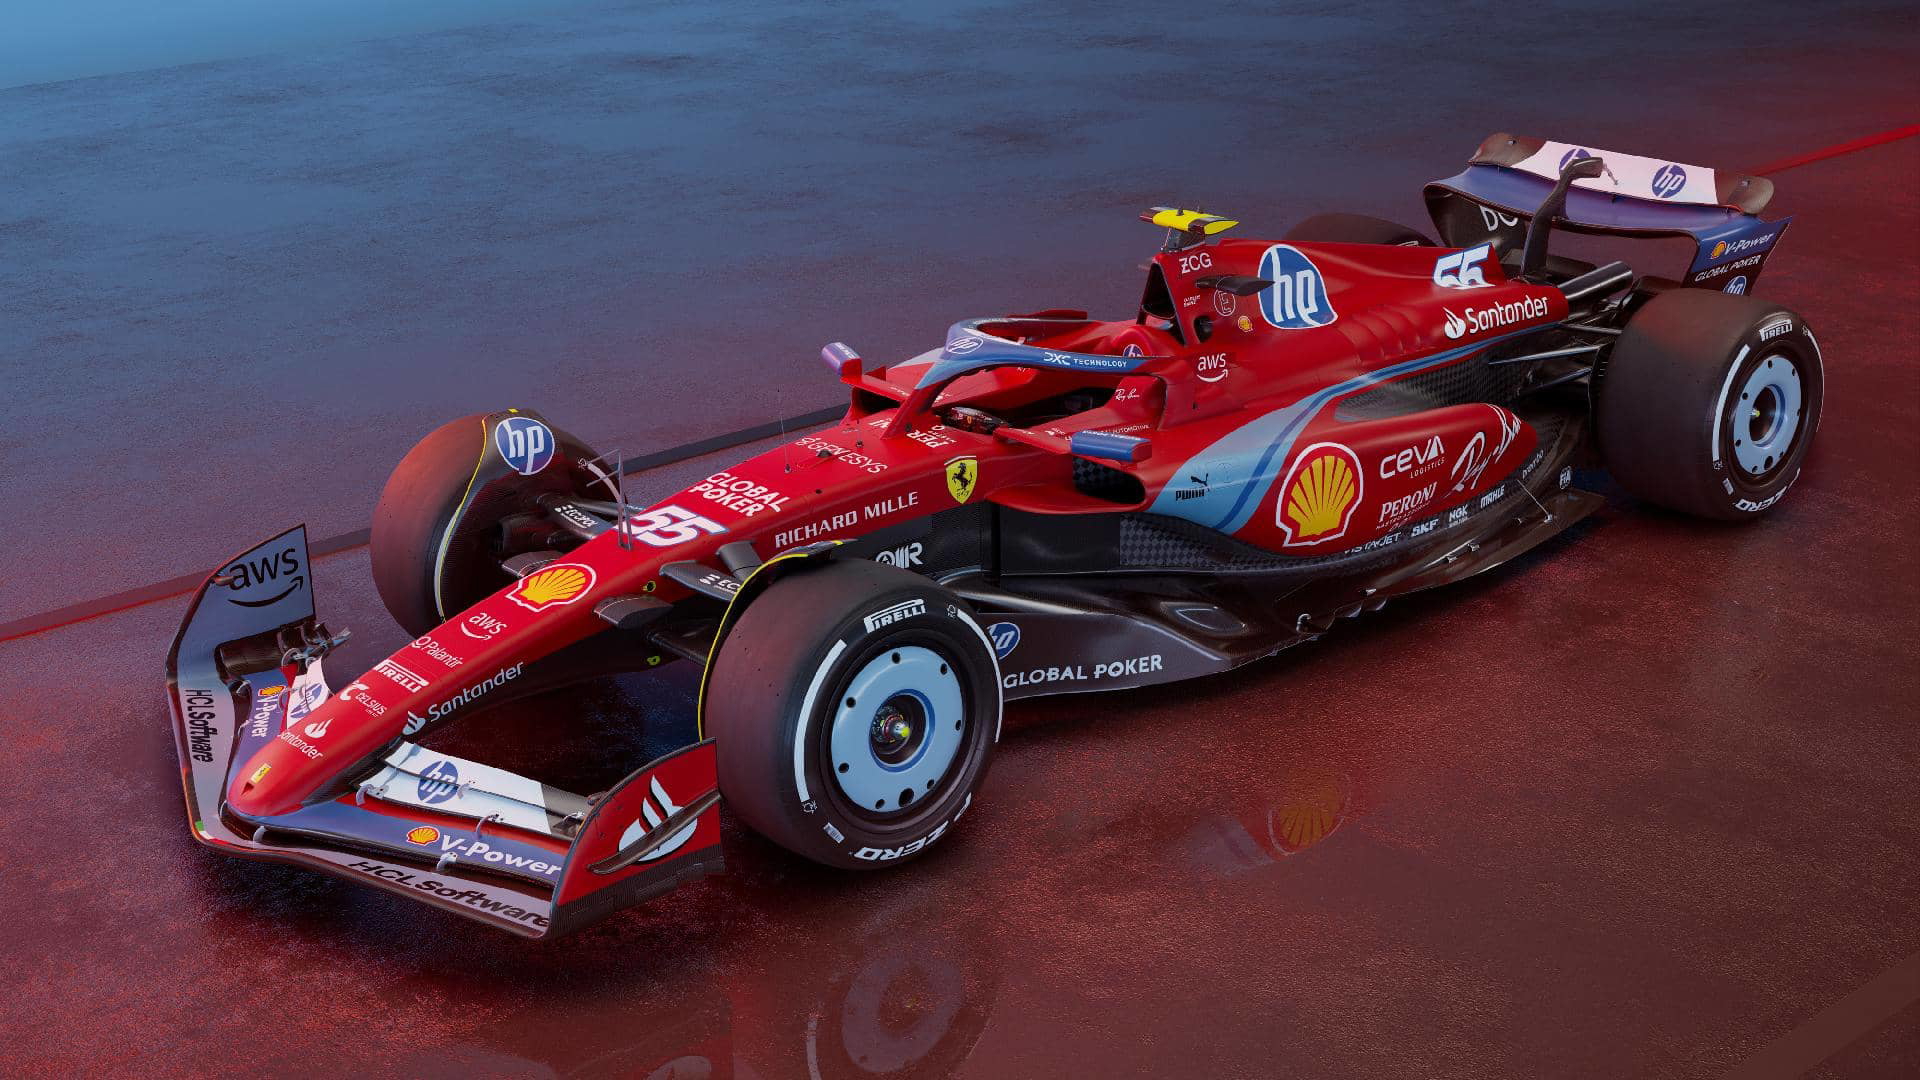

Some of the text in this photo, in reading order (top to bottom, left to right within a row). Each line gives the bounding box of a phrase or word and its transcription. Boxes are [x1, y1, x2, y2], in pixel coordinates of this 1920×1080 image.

[1655, 154, 1685, 198] hp
[1724, 233, 1774, 255] V-Power
[1179, 252, 1212, 274] ZCG
[1433, 243, 1496, 290] 55
[1269, 246, 1319, 327] hp
[1465, 295, 1548, 334] Santander
[1759, 319, 1793, 341] PIRELLI
[1043, 352, 1128, 368] DXC TECHNOLOGY
[1198, 353, 1227, 371] aws
[502, 418, 545, 475] hp
[808, 441, 888, 473] GENESYS
[1410, 457, 1445, 479] LOGISTICS
[689, 483, 765, 517] POKER
[706, 472, 790, 513] GLOBAL
[1378, 481, 1438, 523] PERONI
[1411, 519, 1439, 537] SKF
[1449, 504, 1468, 522] NGK
[1480, 485, 1505, 509] MAHLE
[612, 504, 730, 548] 55
[775, 491, 919, 549] RICHARD MILLE
[228, 547, 300, 591] aws
[469, 612, 508, 636] aws
[863, 599, 926, 634] PIRELLI
[423, 642, 464, 669] Palantir
[1003, 654, 1163, 689] GLOBAL POKER
[372, 659, 430, 693] PIRELLI
[427, 661, 524, 722] Santander
[355, 692, 387, 715] CELSIUS
[440, 834, 562, 876] V-Power
[853, 820, 948, 861] ZERO
